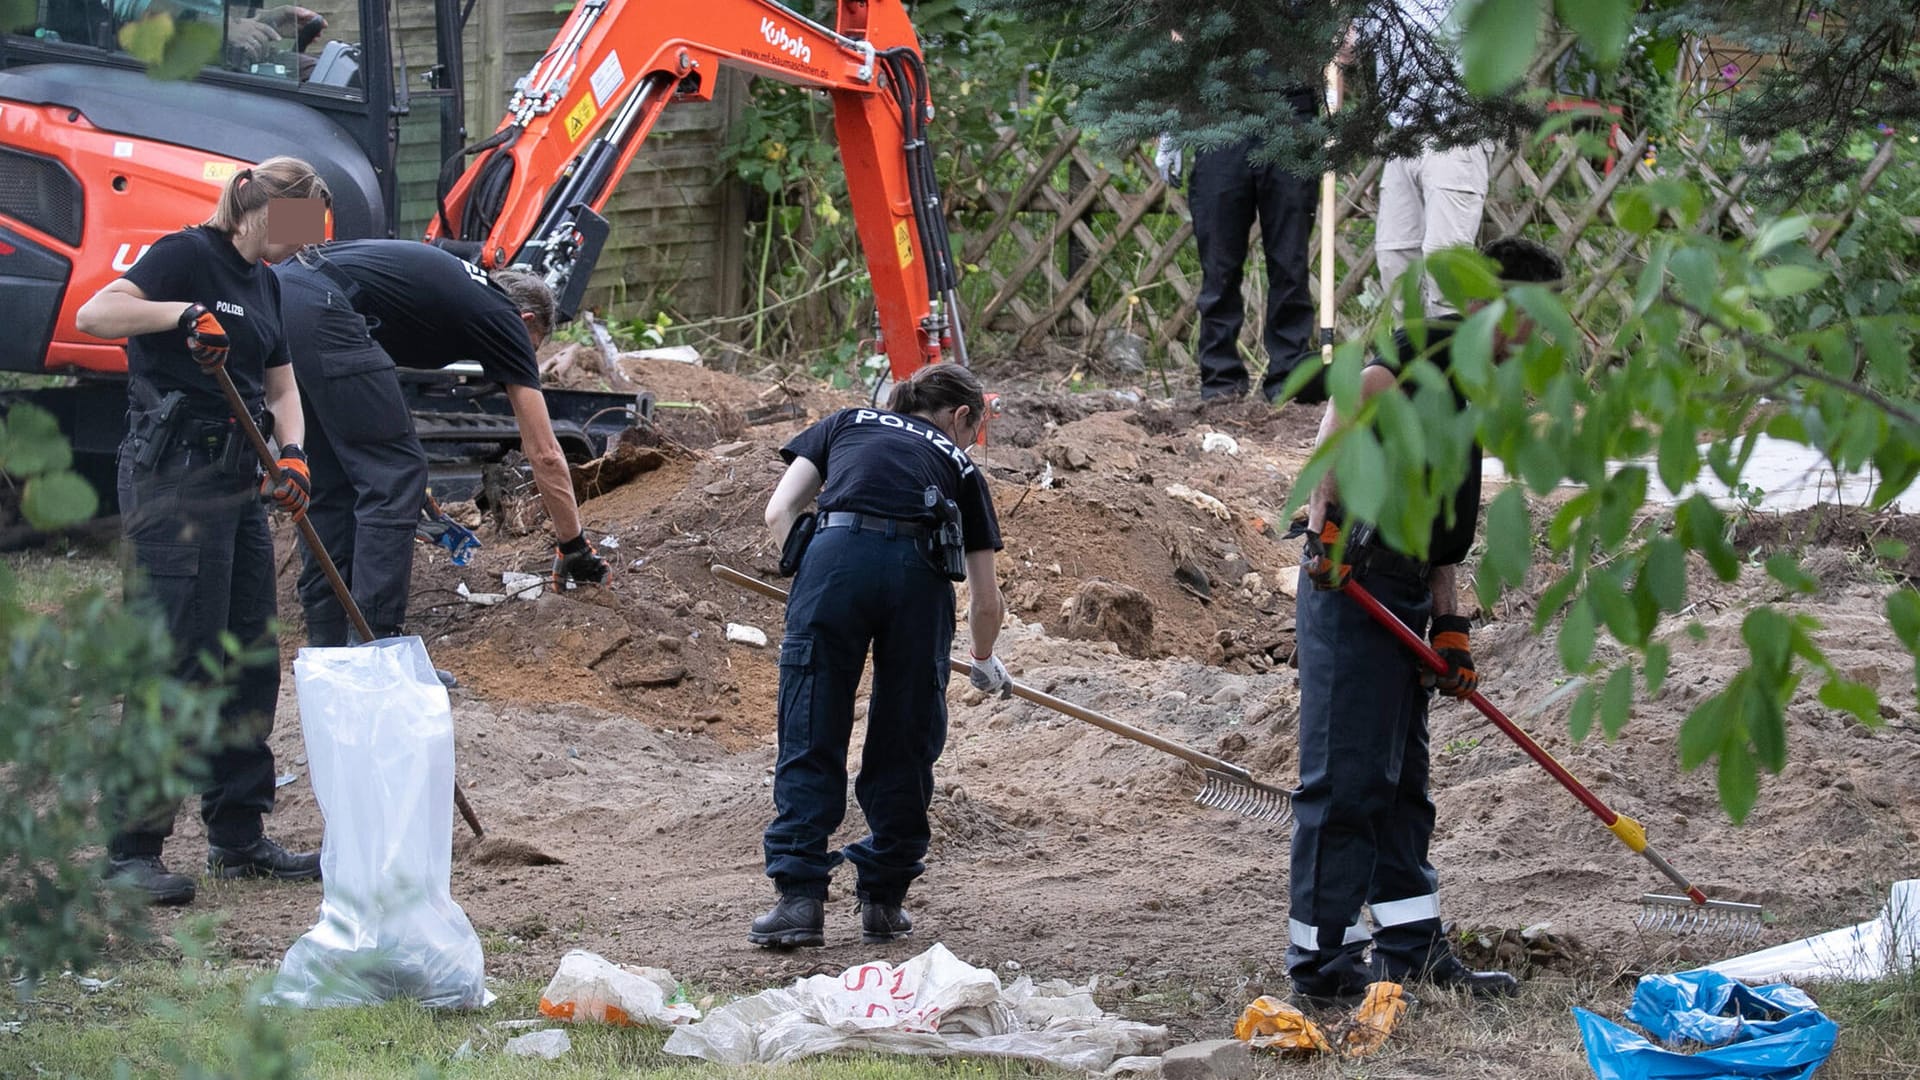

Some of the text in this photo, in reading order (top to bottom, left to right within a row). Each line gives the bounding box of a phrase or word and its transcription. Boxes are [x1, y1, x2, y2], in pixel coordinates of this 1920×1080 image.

[760, 16, 812, 64] Kubota
[216, 300, 244, 317] POLIZEI
[855, 409, 975, 479] POLIZEI
